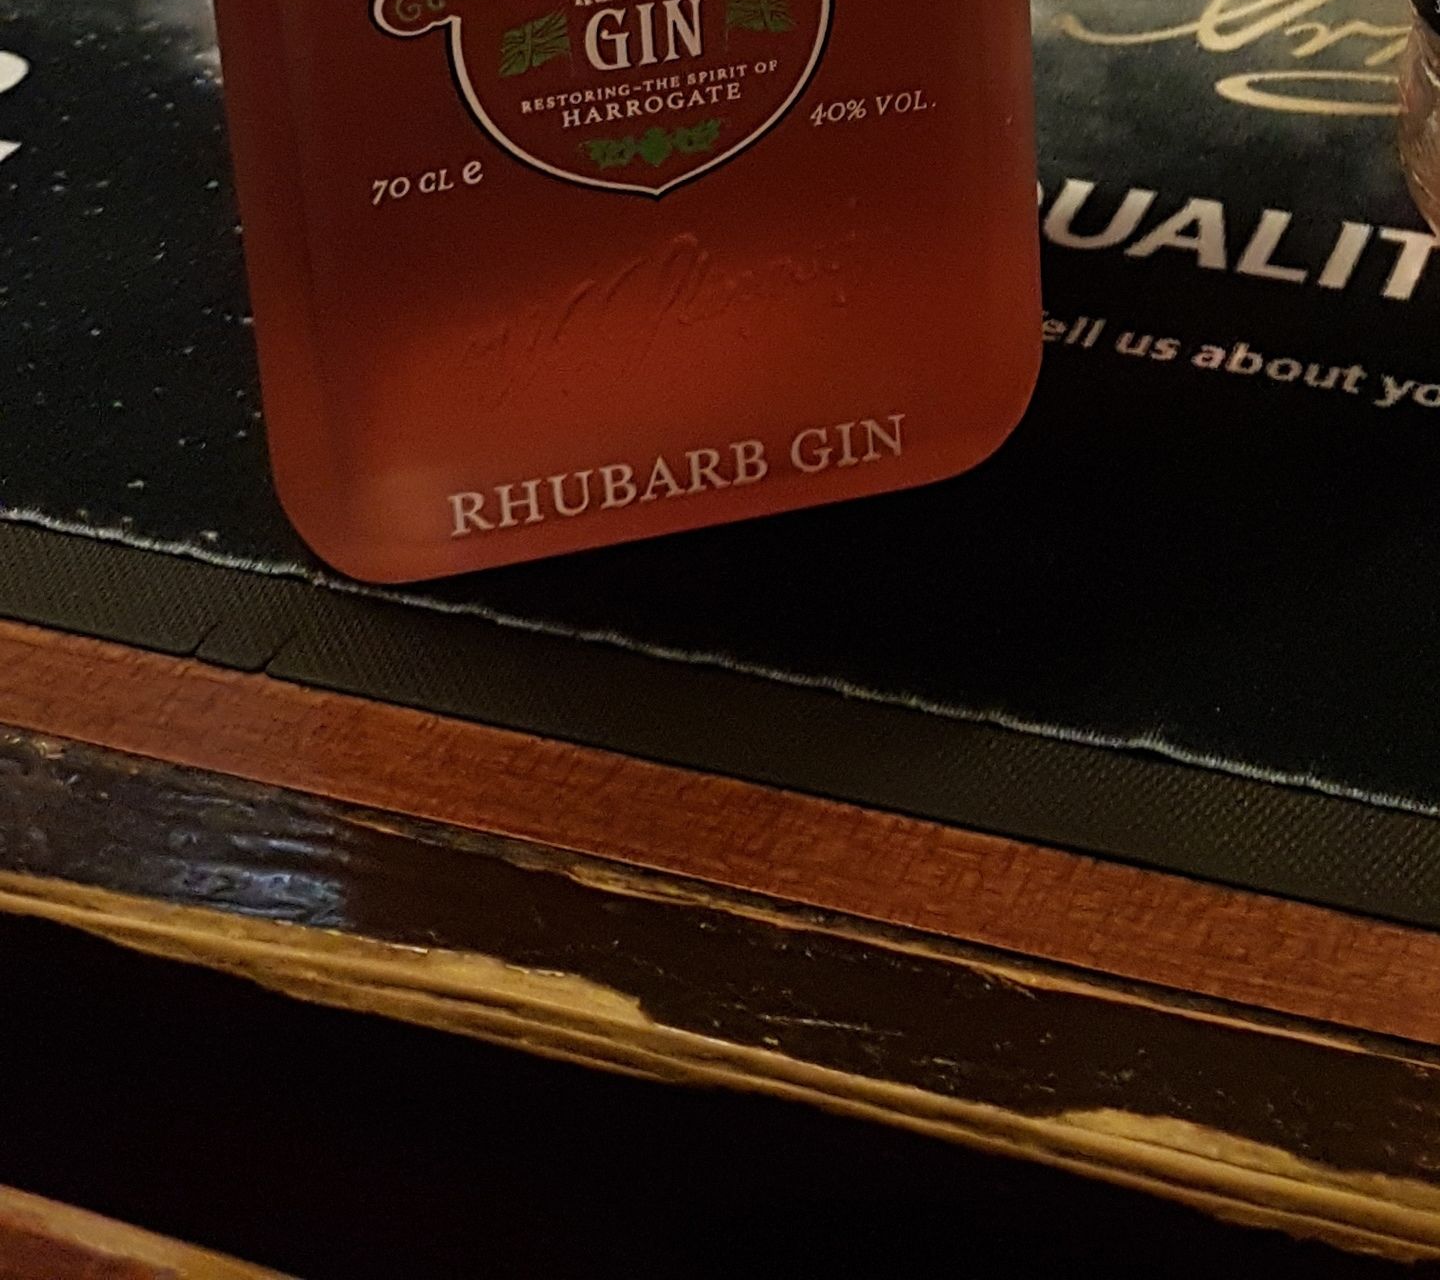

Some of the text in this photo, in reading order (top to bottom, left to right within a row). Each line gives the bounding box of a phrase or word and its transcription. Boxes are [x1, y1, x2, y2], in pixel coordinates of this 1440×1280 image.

[686, 64, 748, 87] SPIRIT
[754, 59, 779, 75] OF
[561, 81, 743, 128] HARROGATE
[810, 98, 868, 127] 40%
[371, 175, 411, 206] 70
[1114, 323, 1182, 362] us
[1191, 341, 1369, 394] about
[448, 413, 908, 538] RHUBARB GIN
